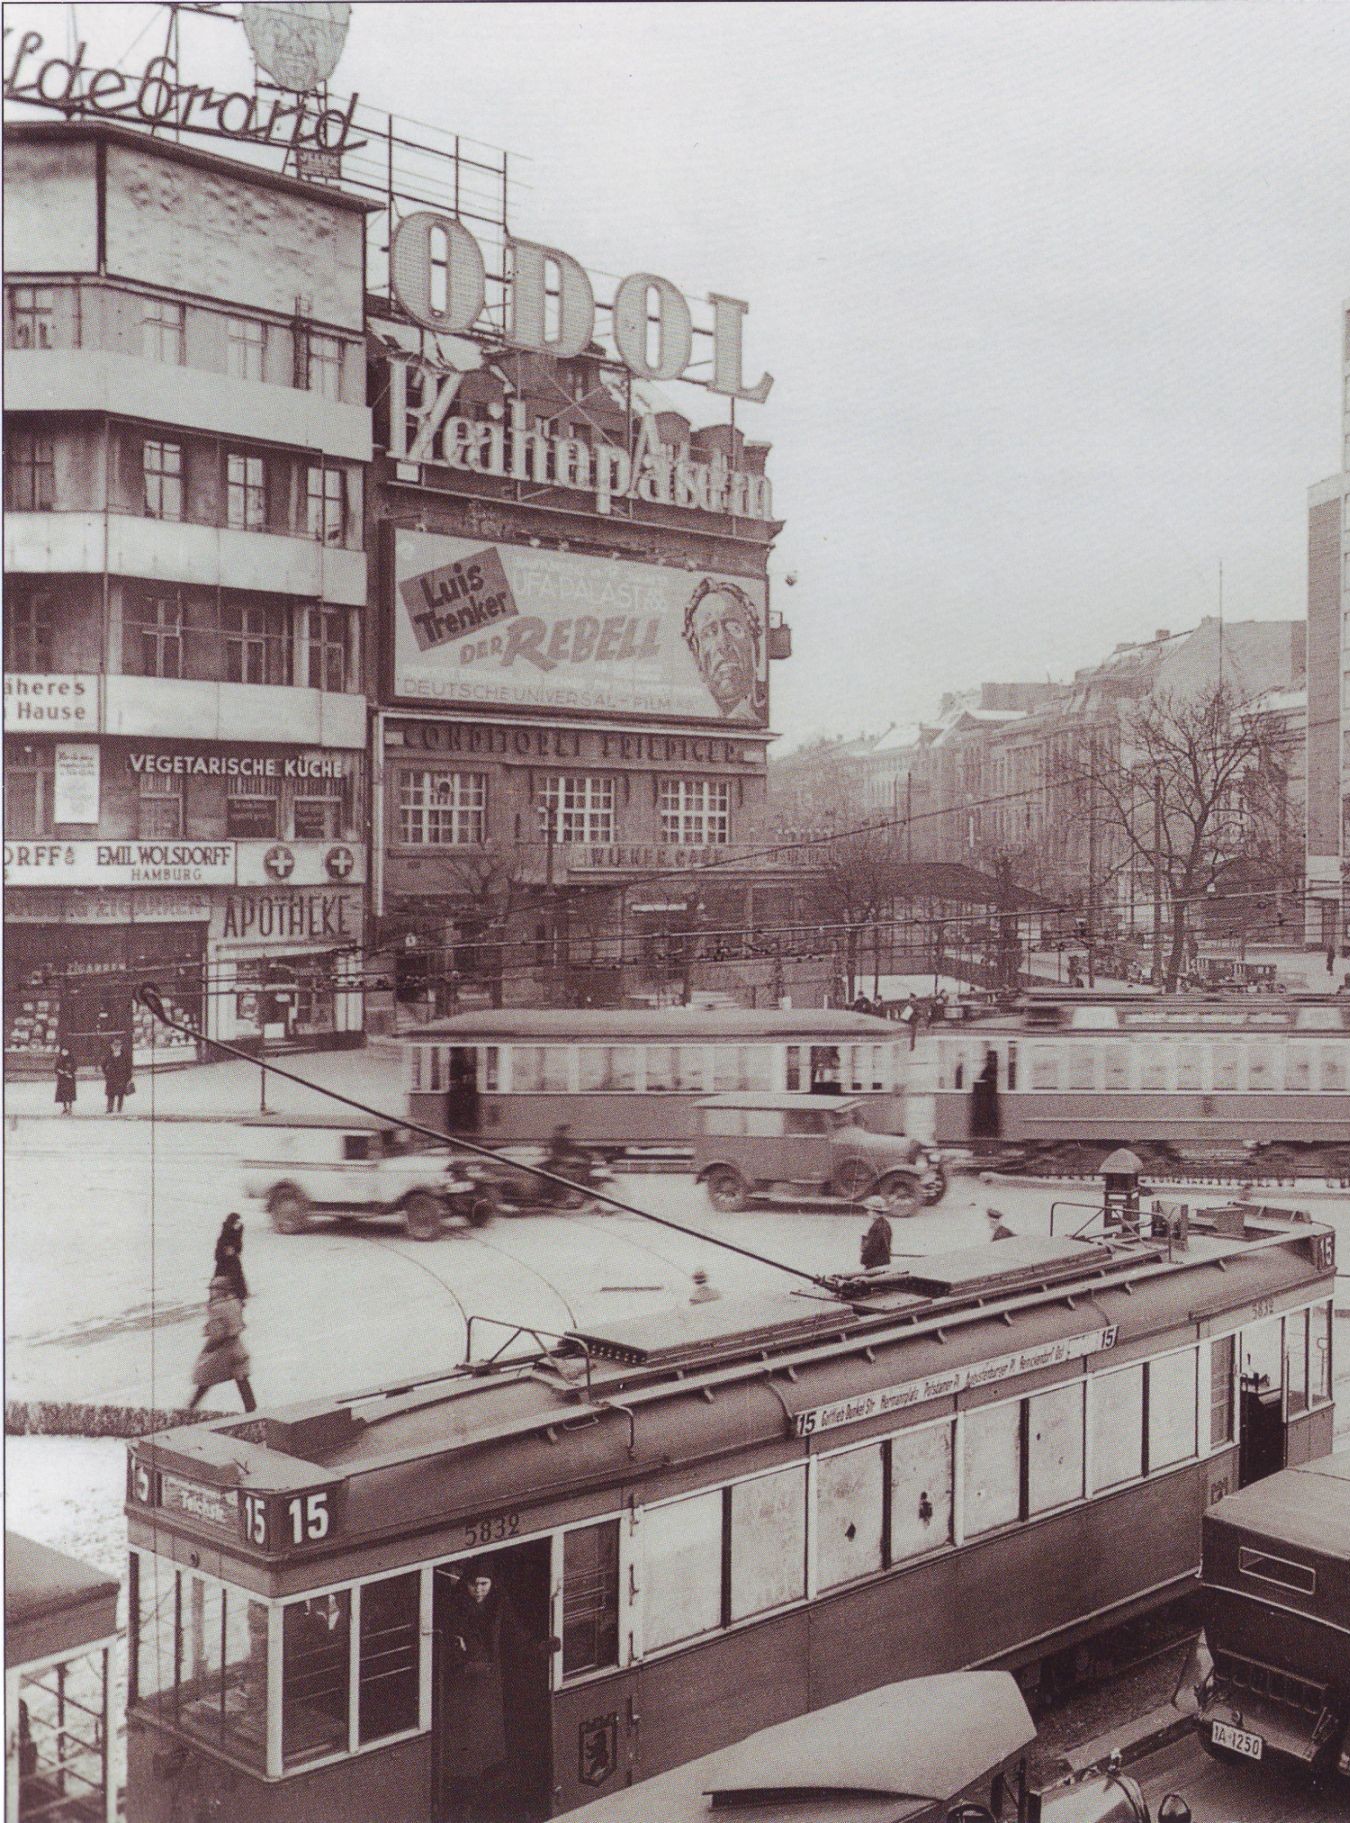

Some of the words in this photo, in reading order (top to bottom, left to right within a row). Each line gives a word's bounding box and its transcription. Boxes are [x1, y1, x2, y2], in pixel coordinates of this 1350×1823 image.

[387, 210, 775, 403] ODOL
[420, 561, 485, 609] Luis
[414, 589, 507, 643] Trenker
[500, 614, 662, 673] REBELL
[402, 677, 513, 701] DEUTSCHE
[17, 701, 86, 720] Hause
[129, 753, 276, 777] VEGETARISCHE
[284, 754, 342, 779] KÜCHE
[96, 845, 136, 866] EMIL
[139, 845, 232, 866] WOLSDORFF
[131, 868, 203, 881] HAMBURG
[222, 894, 351, 939] APOTHEKE
[1100, 1326, 1116, 1349] 15
[798, 1411, 817, 1437] 15
[245, 1495, 266, 1545] 15
[288, 1491, 329, 1544] 15
[464, 1513, 520, 1547] 5832
